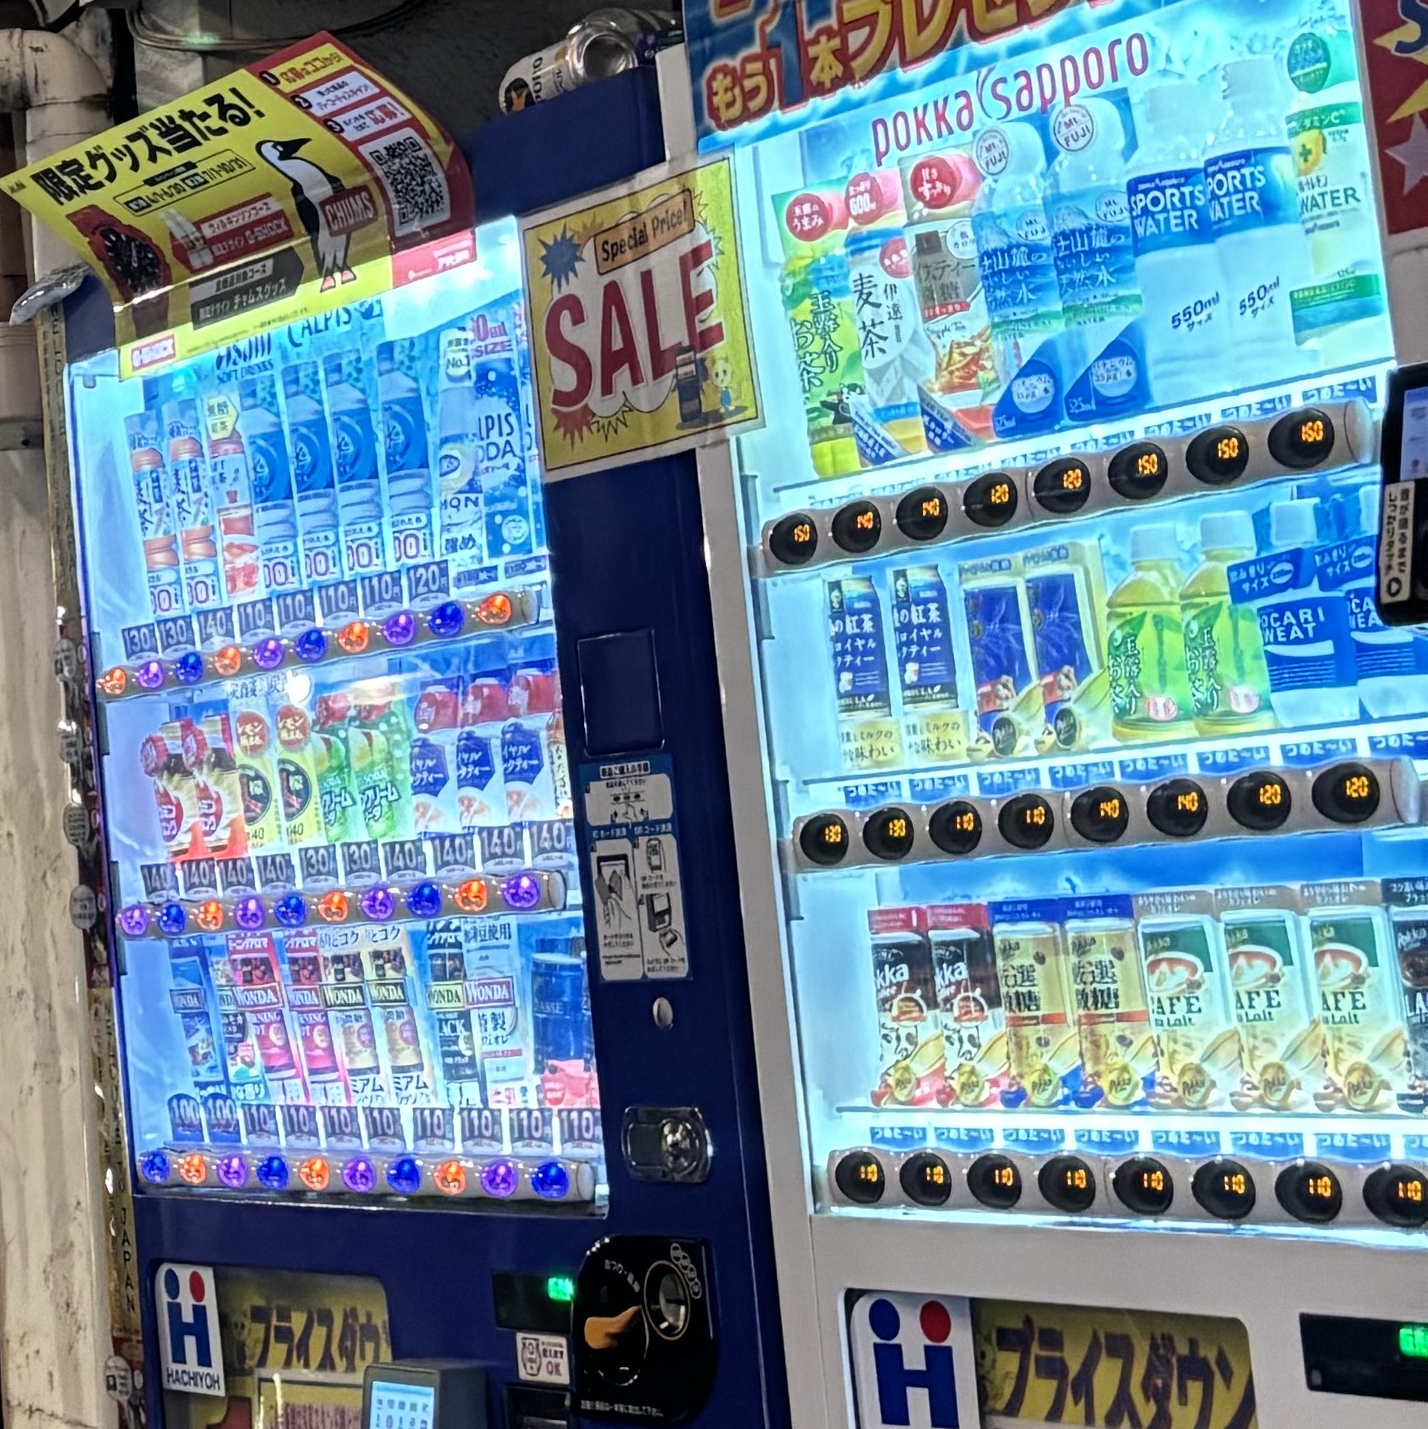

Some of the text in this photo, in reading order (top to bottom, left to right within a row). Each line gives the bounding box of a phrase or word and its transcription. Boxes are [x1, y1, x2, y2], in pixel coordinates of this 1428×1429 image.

[991, 32, 1148, 121] sapporo
[1062, 124, 1091, 149] FUJI
[1206, 165, 1267, 200] PORTS
[325, 192, 373, 231] CHUMS
[1130, 183, 1206, 216] SPORTS
[601, 199, 689, 264] Special Price!
[1134, 208, 1199, 238] WATER
[545, 241, 725, 409] SALE
[851, 272, 890, 360] 麦茶
[1260, 606, 1326, 628] OCARI
[1263, 622, 1317, 644] WEAT
[876, 962, 909, 989] kka
[935, 960, 969, 989] kka
[233, 986, 279, 1008] WONDA
[324, 986, 364, 1007] WONDA
[466, 978, 510, 1004] WONDA
[1235, 989, 1282, 1010] AFE
[1322, 990, 1367, 1011] AFE
[250, 1301, 392, 1374] プライスダウ
[165, 1365, 222, 1393] HACHIYOH
[545, 1359, 564, 1378] OK
